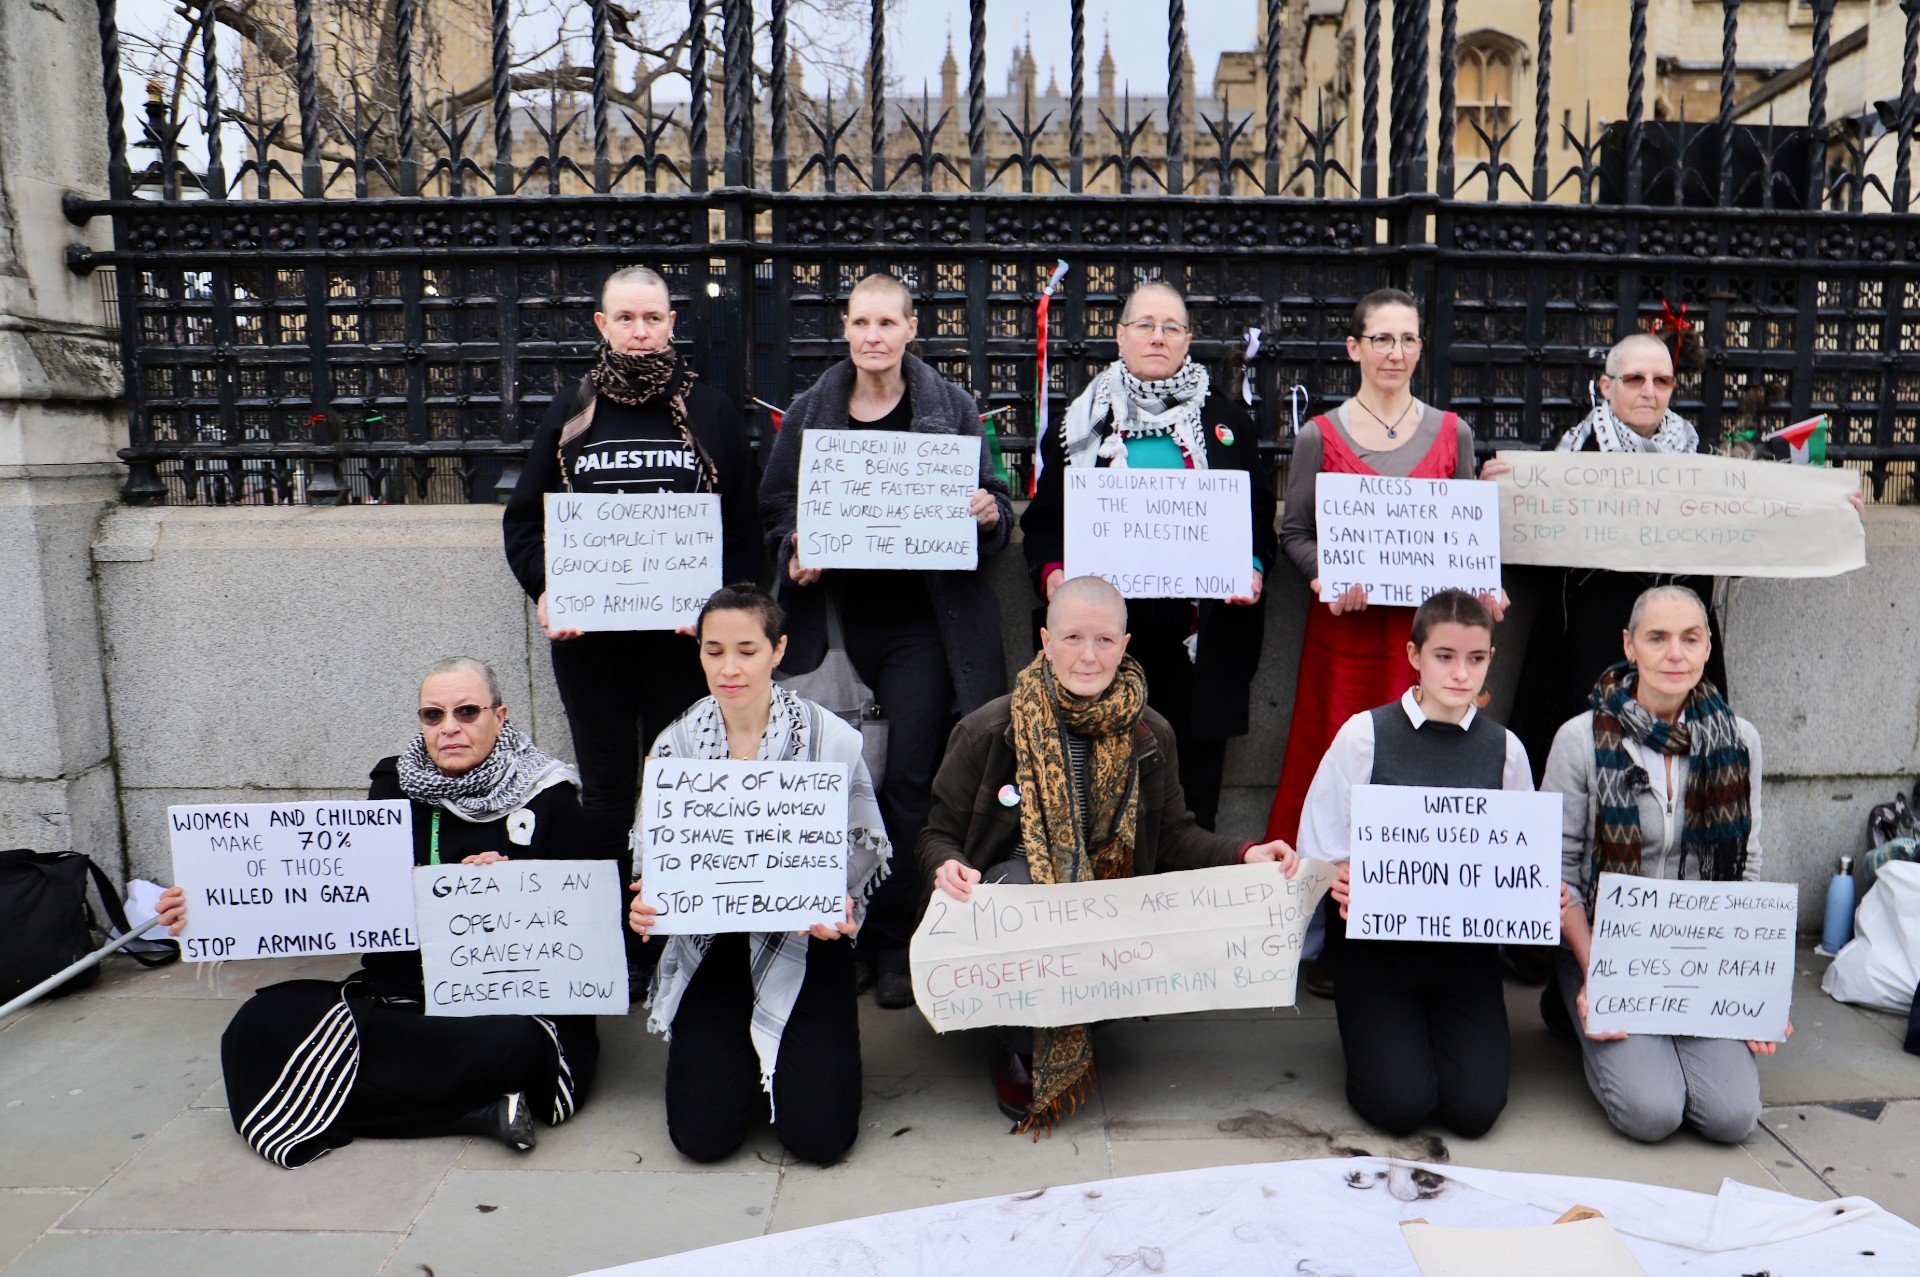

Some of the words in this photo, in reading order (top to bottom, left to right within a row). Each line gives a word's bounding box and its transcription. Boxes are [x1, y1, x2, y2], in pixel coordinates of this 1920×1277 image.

[816, 433, 888, 455] CHILDREN
[893, 436, 906, 454] IN
[917, 442, 960, 457] GAZA
[575, 450, 696, 474] PALESTINE
[811, 459, 845, 473] ARE
[866, 458, 909, 476] BEING
[916, 463, 974, 476] STARVED
[809, 480, 831, 495] AT
[841, 480, 873, 496] THE
[881, 482, 935, 496] FASTEST
[941, 484, 974, 497] RATE
[1071, 475, 1086, 489] IN
[1098, 475, 1186, 491] SOLIDARITY
[1199, 478, 1238, 493] WITH
[1359, 478, 1412, 496] ACCESS
[1428, 482, 1448, 496] TO
[1512, 466, 1550, 488] UK
[1564, 467, 1703, 488] COMPLICIT
[1725, 470, 1746, 489] IN
[557, 501, 583, 522] UK
[597, 502, 709, 521] GOVERNMENT
[800, 500, 832, 517] THE
[840, 503, 883, 518] WORLD
[887, 505, 909, 519] HAS
[914, 505, 942, 520] EVER
[1097, 498, 1128, 513] THE
[1146, 501, 1207, 517] WOMEN
[1323, 500, 1375, 516] CLEAN
[1386, 503, 1438, 519] WATER
[1451, 506, 1483, 520] AND
[1513, 495, 1660, 516] PALESTINIAN
[1680, 499, 1803, 518] GENOCIDE
[563, 528, 577, 548] IS
[583, 531, 667, 547] COMPLICIT
[676, 531, 714, 546] WITH
[1093, 522, 1112, 538] OF
[1124, 523, 1210, 542] PALESTINE
[1330, 527, 1434, 545] SANITATION
[1444, 532, 1458, 545] IS
[1468, 533, 1479, 546] A
[1513, 523, 1566, 543] STOP
[1583, 525, 1622, 543] THE
[1640, 526, 1759, 545] BLOCKADE
[808, 532, 852, 555] STOP
[865, 536, 895, 554] THE
[905, 538, 970, 555] BLOCKADE
[551, 557, 633, 575] GENOCIDE
[643, 552, 659, 572] IN
[1323, 550, 1365, 565] BASIC
[1380, 551, 1434, 566] HUMAN
[1449, 554, 1496, 570] RIGHT
[1090, 573, 1184, 595] ASEFIRE
[1196, 576, 1235, 594] NOW
[1332, 582, 1374, 599] STP
[1380, 584, 1413, 602] THE
[556, 595, 595, 614] STOP
[603, 595, 663, 614] ARMING
[672, 595, 709, 613] ISRAE
[656, 768, 729, 792] LACK
[742, 771, 774, 790] OF
[780, 772, 842, 792] WATER
[657, 794, 672, 818] IS
[684, 797, 761, 818] FORCING
[768, 802, 825, 817] WOMEN
[1425, 795, 1487, 815] WATER
[173, 812, 249, 831] WOMEN
[270, 810, 305, 828] AND
[317, 808, 402, 826] CHILDREN
[210, 835, 263, 852] MAKE
[298, 831, 351, 850] 70%
[649, 825, 675, 845] TO
[680, 829, 734, 845] SHAVE
[744, 823, 792, 844] THEIR
[799, 830, 843, 845] HEADS
[1359, 826, 1373, 841] IS
[1382, 826, 1430, 843] BEING
[1437, 827, 1479, 844] USED
[1488, 830, 1508, 845] AS
[1516, 832, 1528, 846] A
[247, 859, 266, 877] OF
[281, 858, 345, 876] THOSE
[653, 854, 681, 872] TO
[691, 853, 760, 871] PREVENT
[767, 851, 843, 870] DISEASES.
[432, 876, 500, 898] GAZA
[520, 872, 542, 893] IS
[562, 872, 591, 891] AN
[1362, 859, 1449, 886] WEAPON
[1460, 864, 1482, 888] OF
[1495, 864, 1549, 889] WAR.
[206, 888, 273, 906] KILLED
[285, 888, 307, 904] IN
[321, 886, 370, 903] GAZA
[656, 891, 703, 916] STOP
[712, 895, 749, 916] THE
[752, 895, 843, 913] BLOCKADE
[1607, 885, 1658, 908] 1.5M
[1668, 892, 1718, 910] PEOPLE
[1725, 894, 1796, 911] SHELTERING
[449, 906, 568, 936] OPEN-AIR
[929, 901, 956, 935] 2
[973, 896, 1118, 941] MOTHERS
[1141, 892, 1179, 912] ARE
[1191, 884, 1273, 908] KILLED
[1362, 914, 1407, 935] STOP
[1417, 916, 1451, 937] THE
[1463, 918, 1553, 940] BLOCKADE
[1599, 919, 1642, 939] HAVE
[1650, 923, 1725, 940] NOWHERE
[1734, 929, 1749, 940] TO
[1754, 928, 1787, 940] FLEE
[187, 937, 236, 958] STOP
[258, 933, 336, 955] ARMING
[350, 928, 416, 948] ISRAEL
[1227, 936, 1246, 959] IN
[450, 943, 583, 967] GRAVEYARD
[927, 953, 1082, 998] CEASEFIRE
[1102, 942, 1153, 971] NOW
[1591, 959, 1617, 977] ALL
[1629, 959, 1671, 976] EYES
[1681, 960, 1708, 977] ON
[1718, 960, 1776, 976] RAFAH
[434, 979, 550, 1006] CEASEFIRE
[569, 981, 614, 999] NOW
[932, 997, 983, 1021] END
[992, 988, 1044, 1009] THE
[1061, 969, 1216, 1006] HUMANITARIAN
[1595, 995, 1690, 1015] CEASEFIRE
[1711, 999, 1765, 1018] NOW
